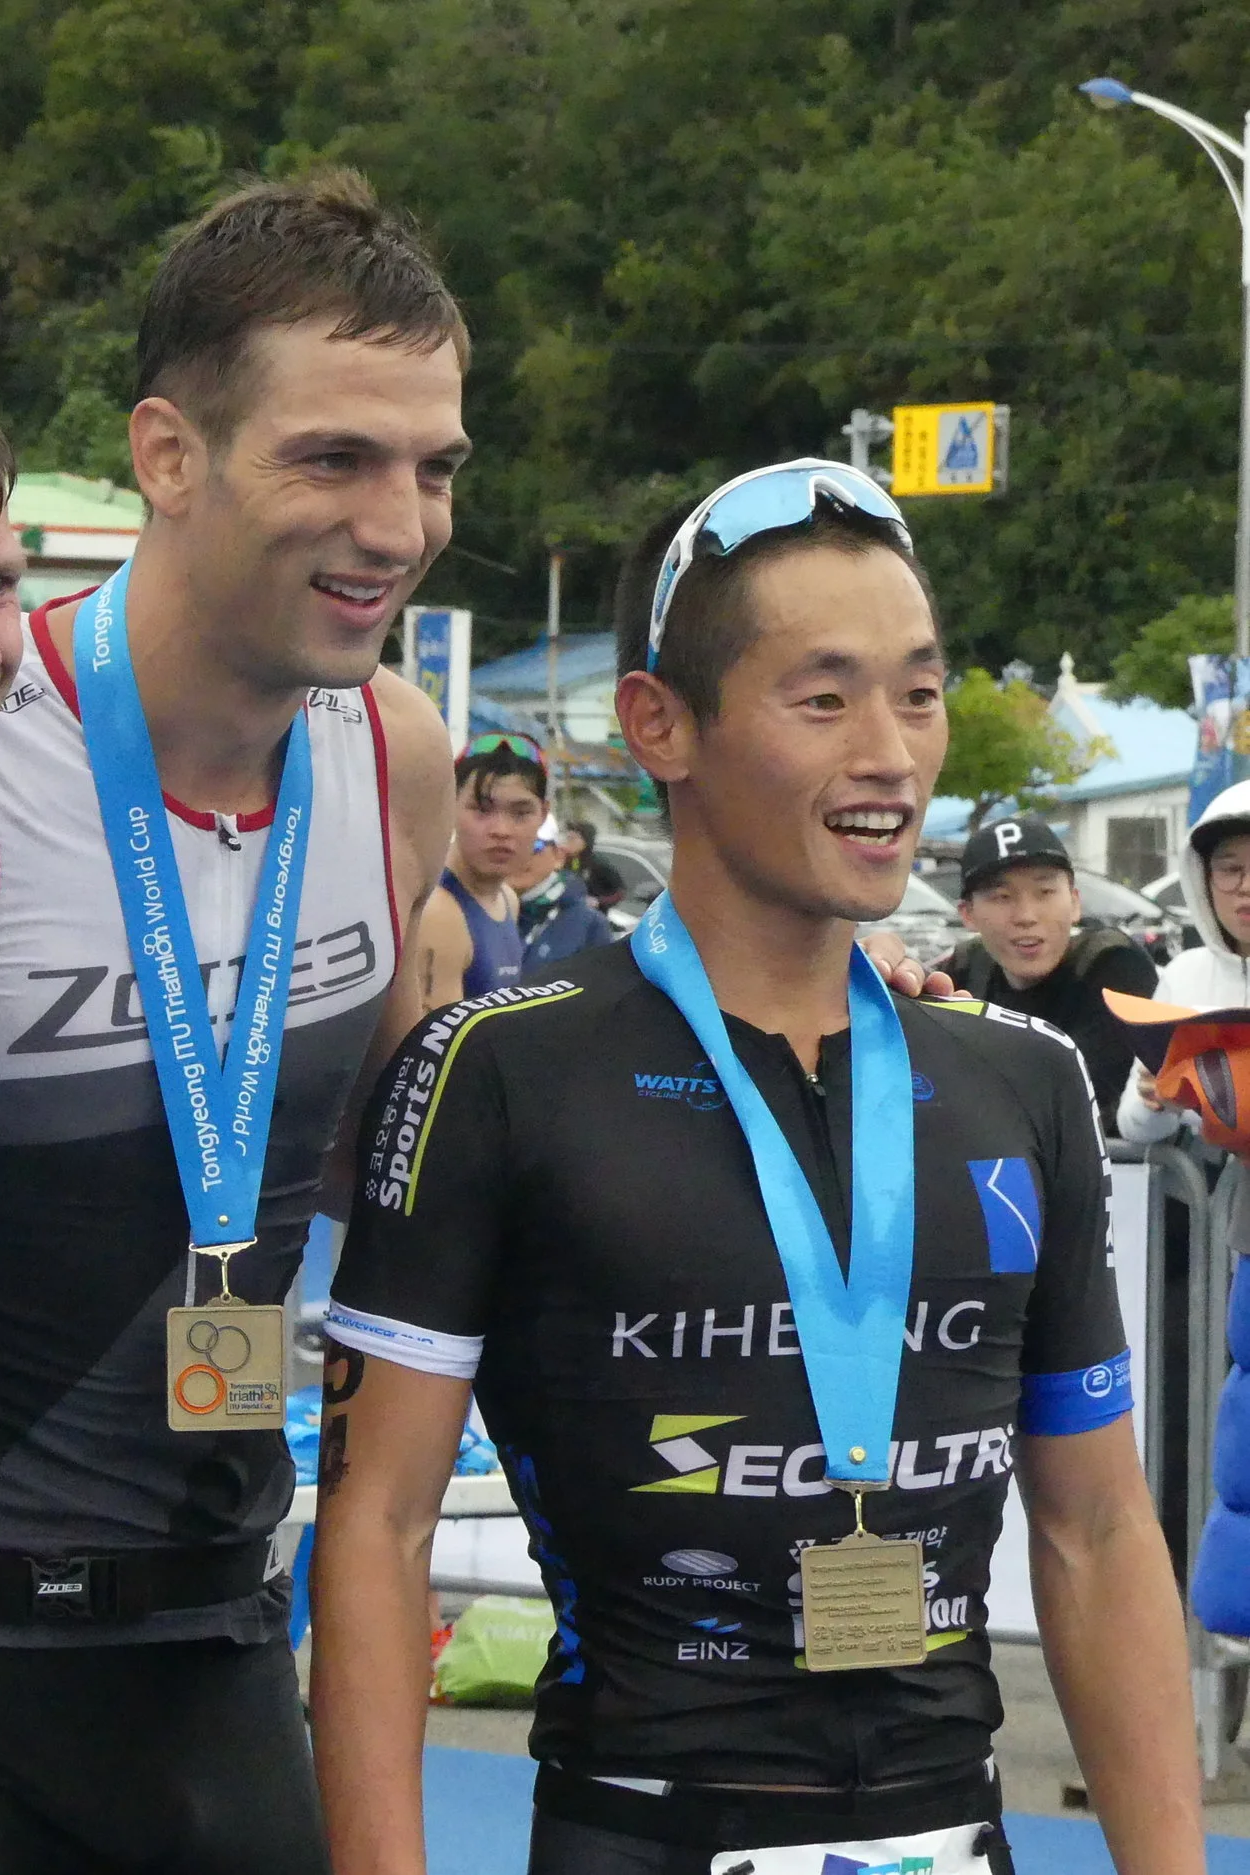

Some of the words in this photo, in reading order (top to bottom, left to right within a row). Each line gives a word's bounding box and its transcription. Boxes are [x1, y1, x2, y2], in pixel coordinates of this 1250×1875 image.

[130, 806, 150, 852] Cup
[995, 822, 1023, 858] P
[142, 856, 167, 925] World
[266, 805, 303, 929] Tongyeong
[650, 923, 668, 954] Cup
[233, 1069, 260, 1137] World
[379, 1059, 437, 1210] Sports
[421, 979, 576, 1056] Nutrition
[634, 1073, 718, 1094] WATTS
[178, 1064, 222, 1192] Tongyeong
[612, 1300, 986, 1358] KIHENG
[643, 1576, 687, 1589] RUDY
[692, 1577, 762, 1593] PROJECT
[677, 1642, 751, 1661] EINZ
